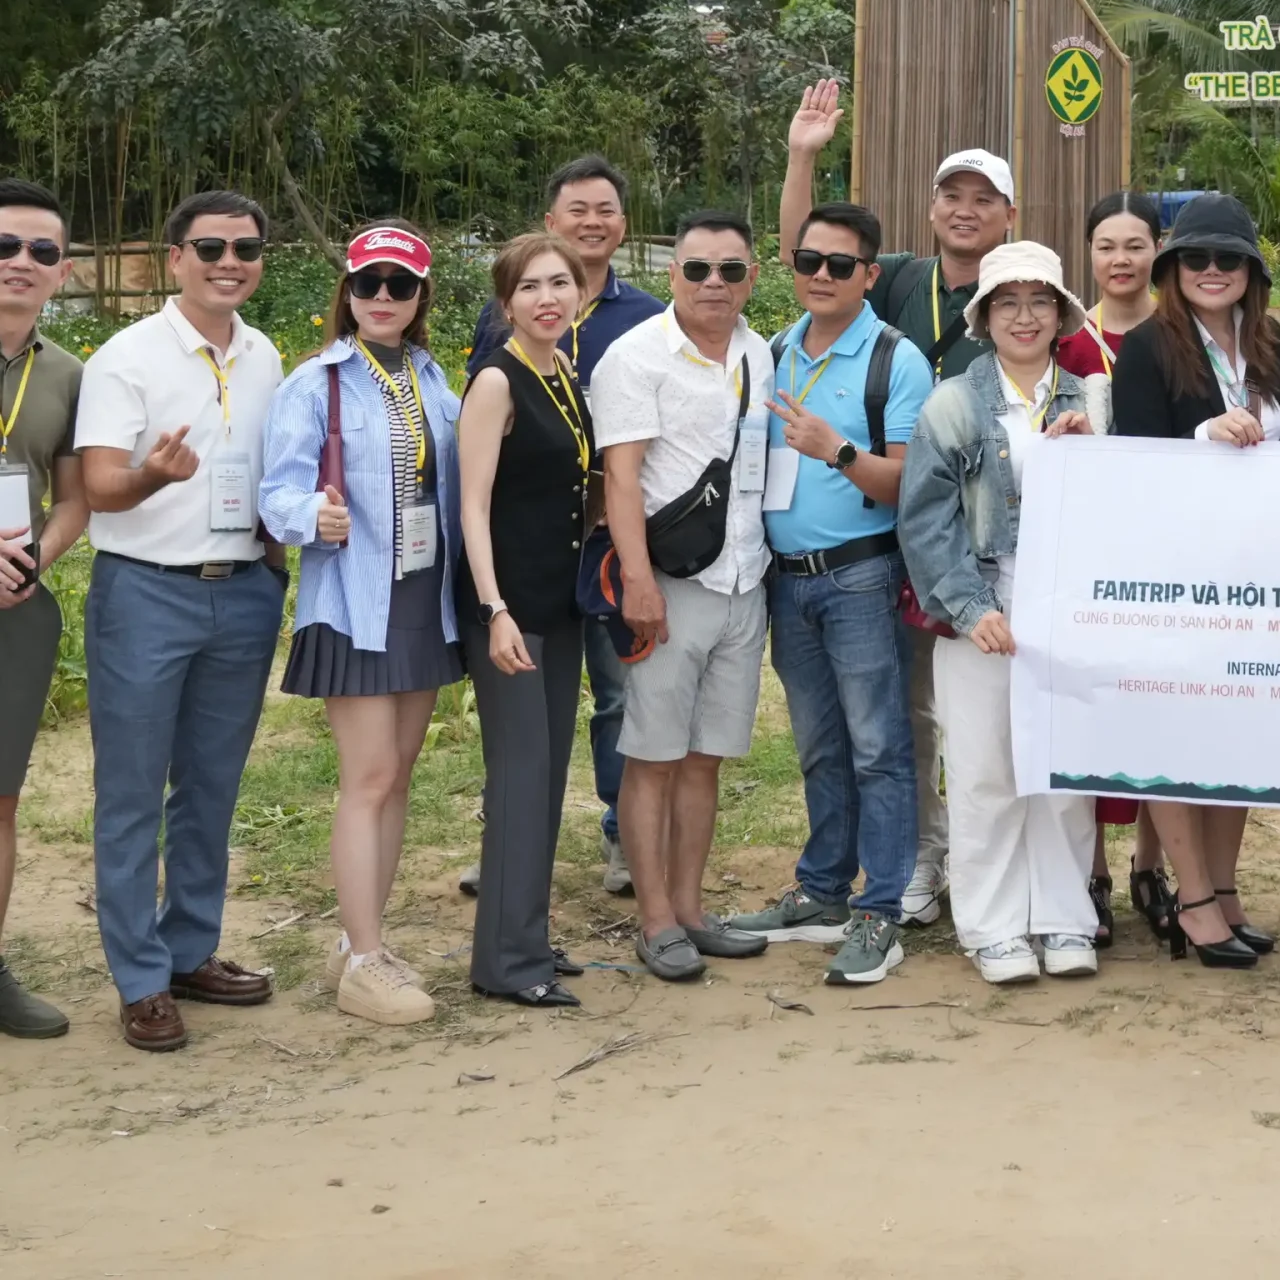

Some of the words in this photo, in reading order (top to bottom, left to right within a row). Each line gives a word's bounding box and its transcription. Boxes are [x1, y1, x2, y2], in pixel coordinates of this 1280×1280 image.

[1222, 17, 1273, 47] TRÀ
[1093, 579, 1185, 603] FAMTRIP
[1192, 581, 1220, 606] VÀ
[1227, 581, 1265, 609] HỘI
[1073, 611, 1109, 625] CUNG
[1235, 618, 1253, 631] AN
[1118, 679, 1176, 694] HERITAGE
[1180, 682, 1207, 695] LINK
[1210, 684, 1234, 698] HOI
[1237, 685, 1255, 698] AN
